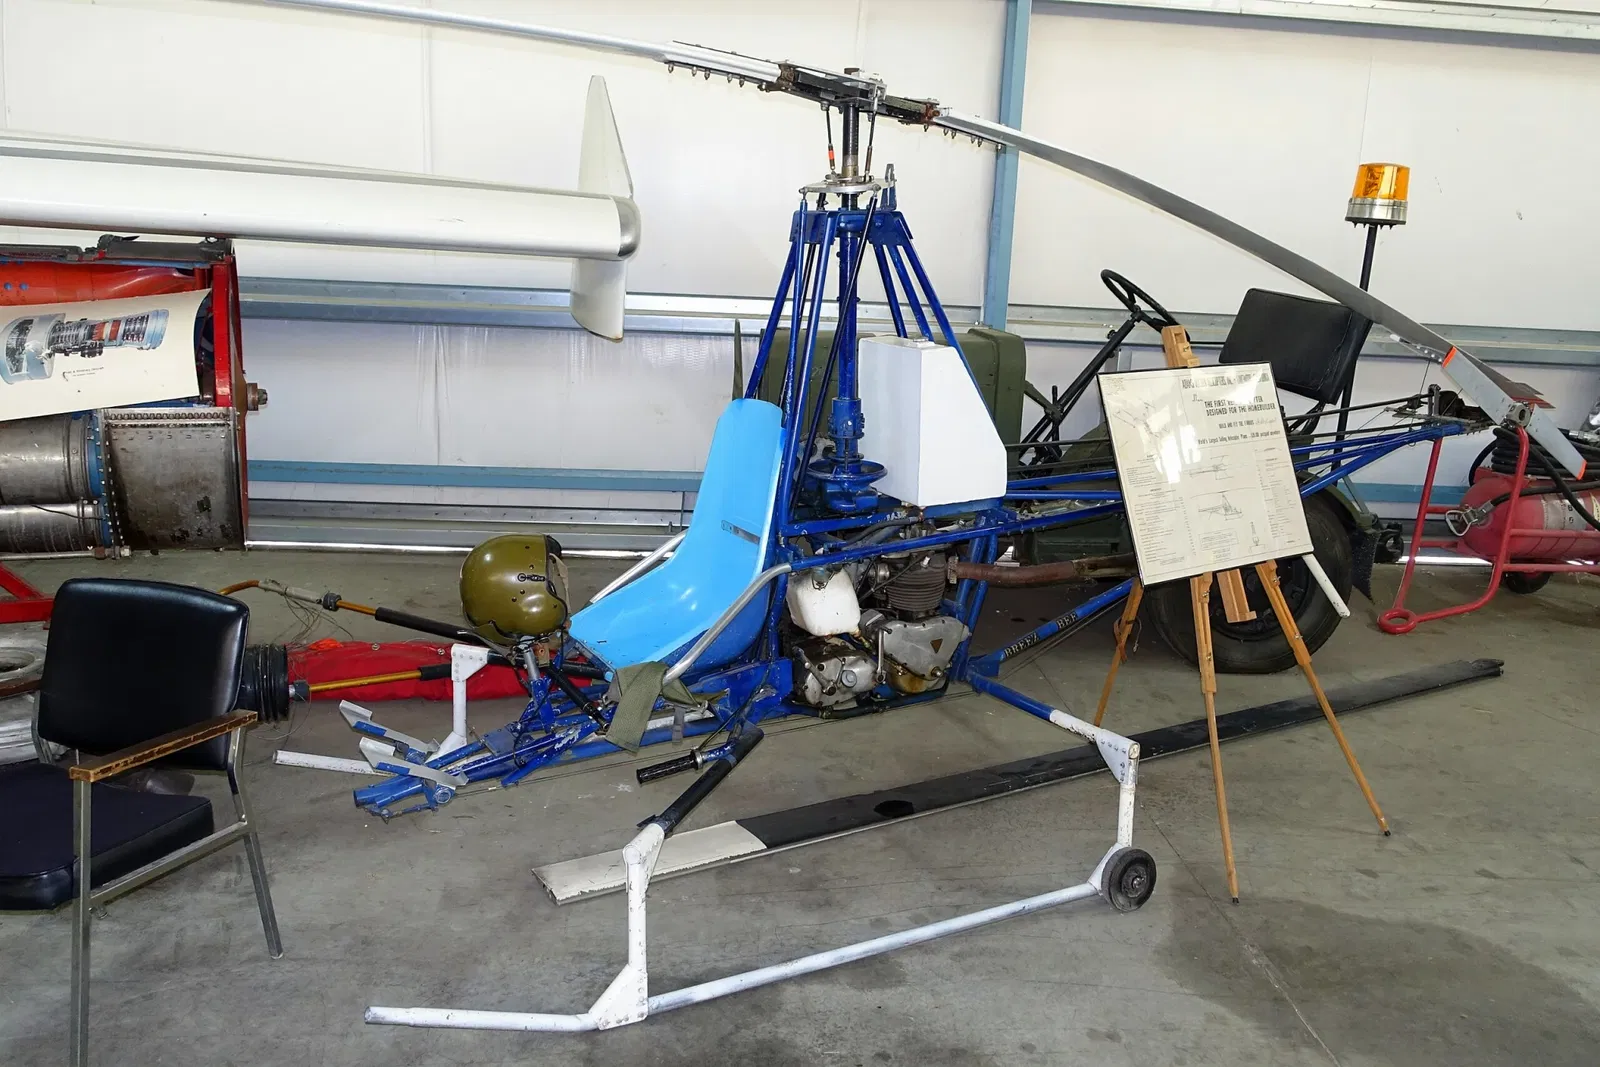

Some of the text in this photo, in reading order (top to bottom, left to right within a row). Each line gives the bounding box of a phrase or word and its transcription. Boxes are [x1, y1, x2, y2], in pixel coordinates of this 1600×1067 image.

[1206, 403, 1276, 416] DESIGNED FOR THE HOMEBUILDER
